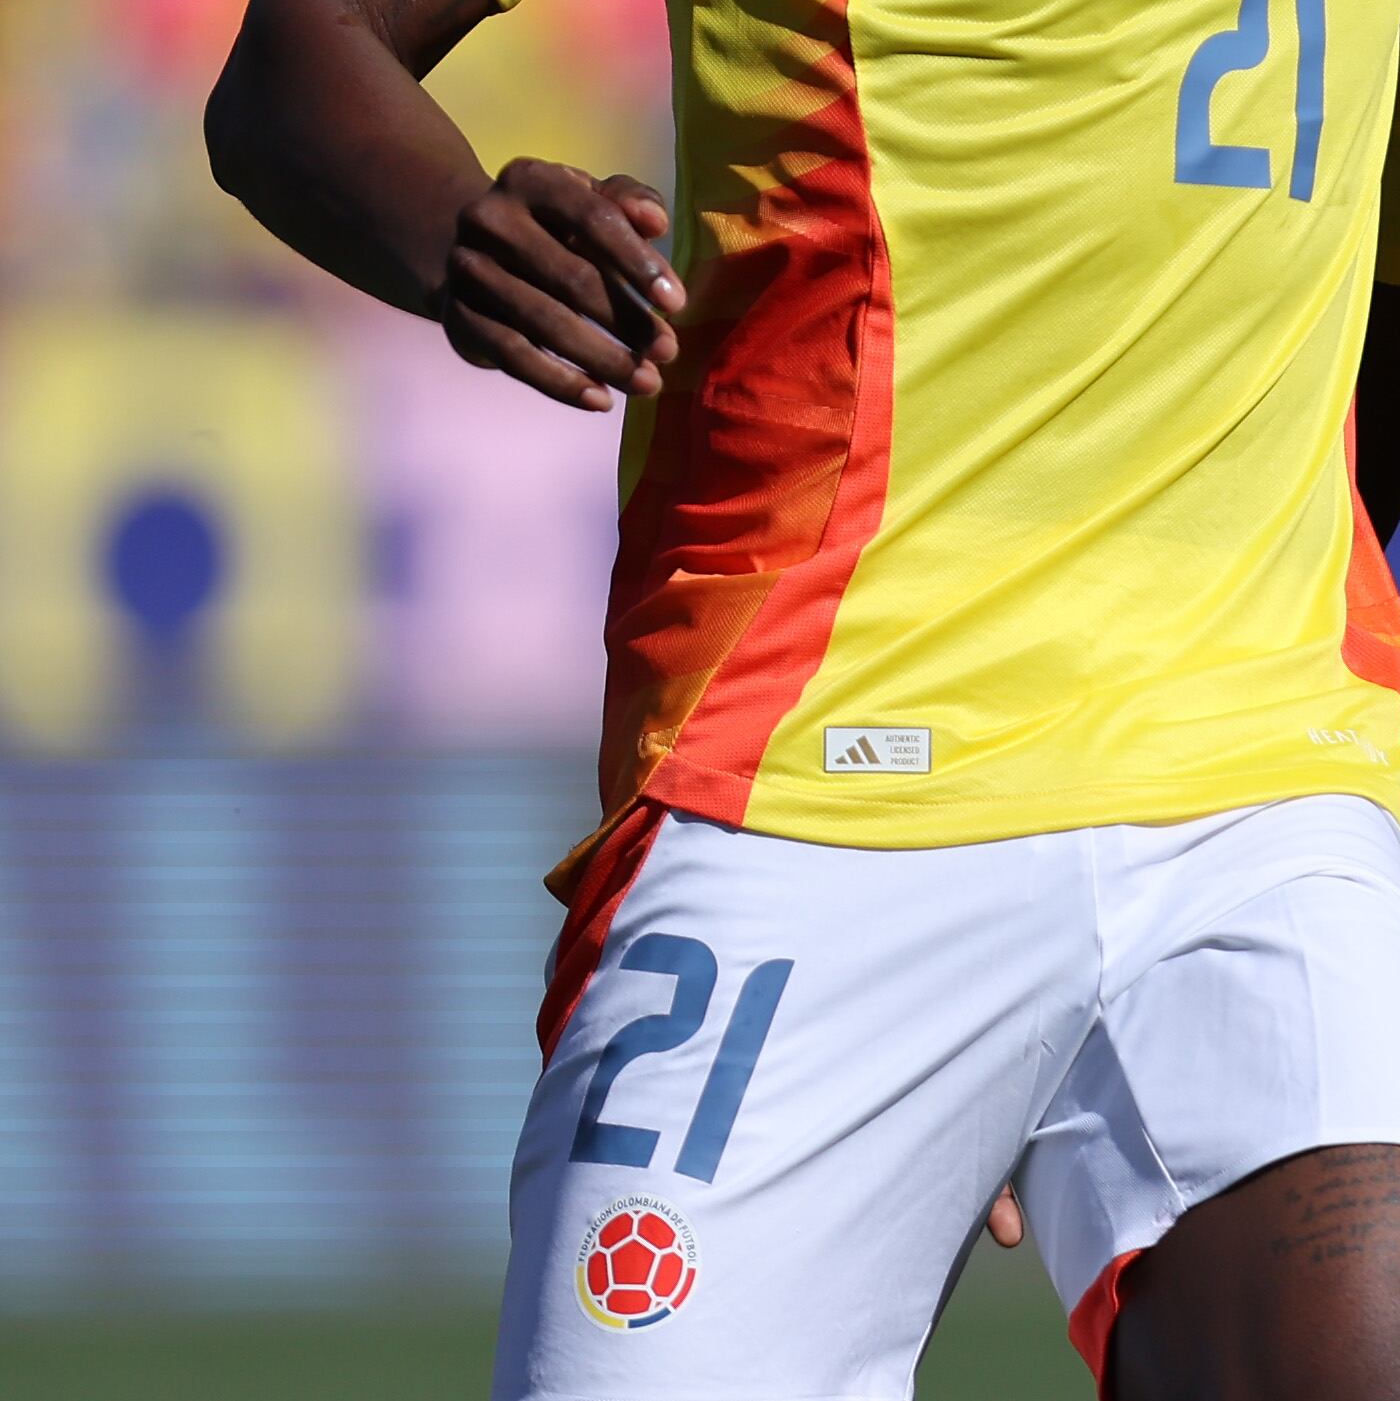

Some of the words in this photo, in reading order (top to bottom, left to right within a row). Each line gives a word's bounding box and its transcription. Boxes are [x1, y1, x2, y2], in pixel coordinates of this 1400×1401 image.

[884, 734, 920, 743] AUTHENTIC
[889, 746, 920, 754] LICENSED
[890, 757, 920, 766] PRODUCT
[569, 932, 795, 1184] 21
[612, 1196, 671, 1217] COLOMBIANA
[669, 1212, 684, 1226] DE
